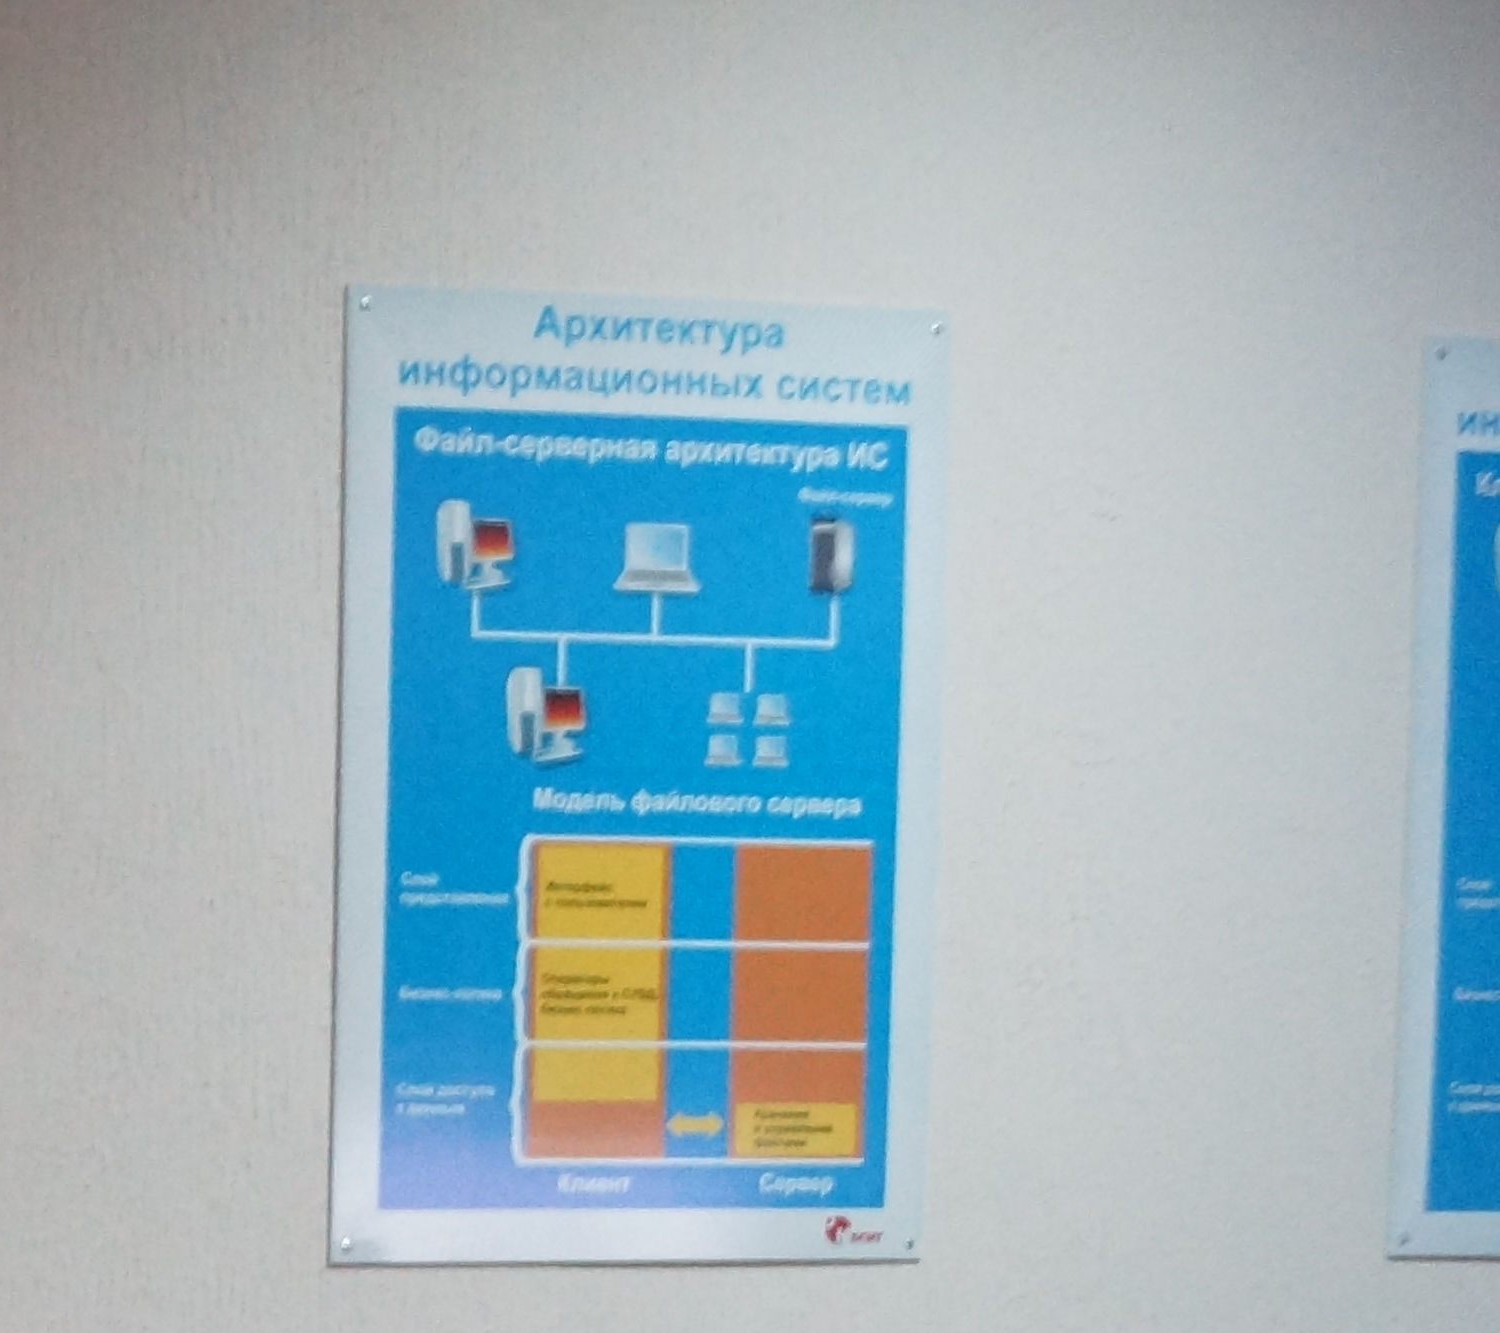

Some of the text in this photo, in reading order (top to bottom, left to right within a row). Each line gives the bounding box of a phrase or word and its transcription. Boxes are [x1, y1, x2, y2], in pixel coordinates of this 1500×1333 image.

[533, 303, 785, 355] Архитектура
[398, 352, 912, 406] информационных систем
[413, 425, 888, 472] Файл-серверная архитектура ИС
[533, 787, 863, 820] Модель файлового сервера
[758, 1171, 835, 1196] Сервер
